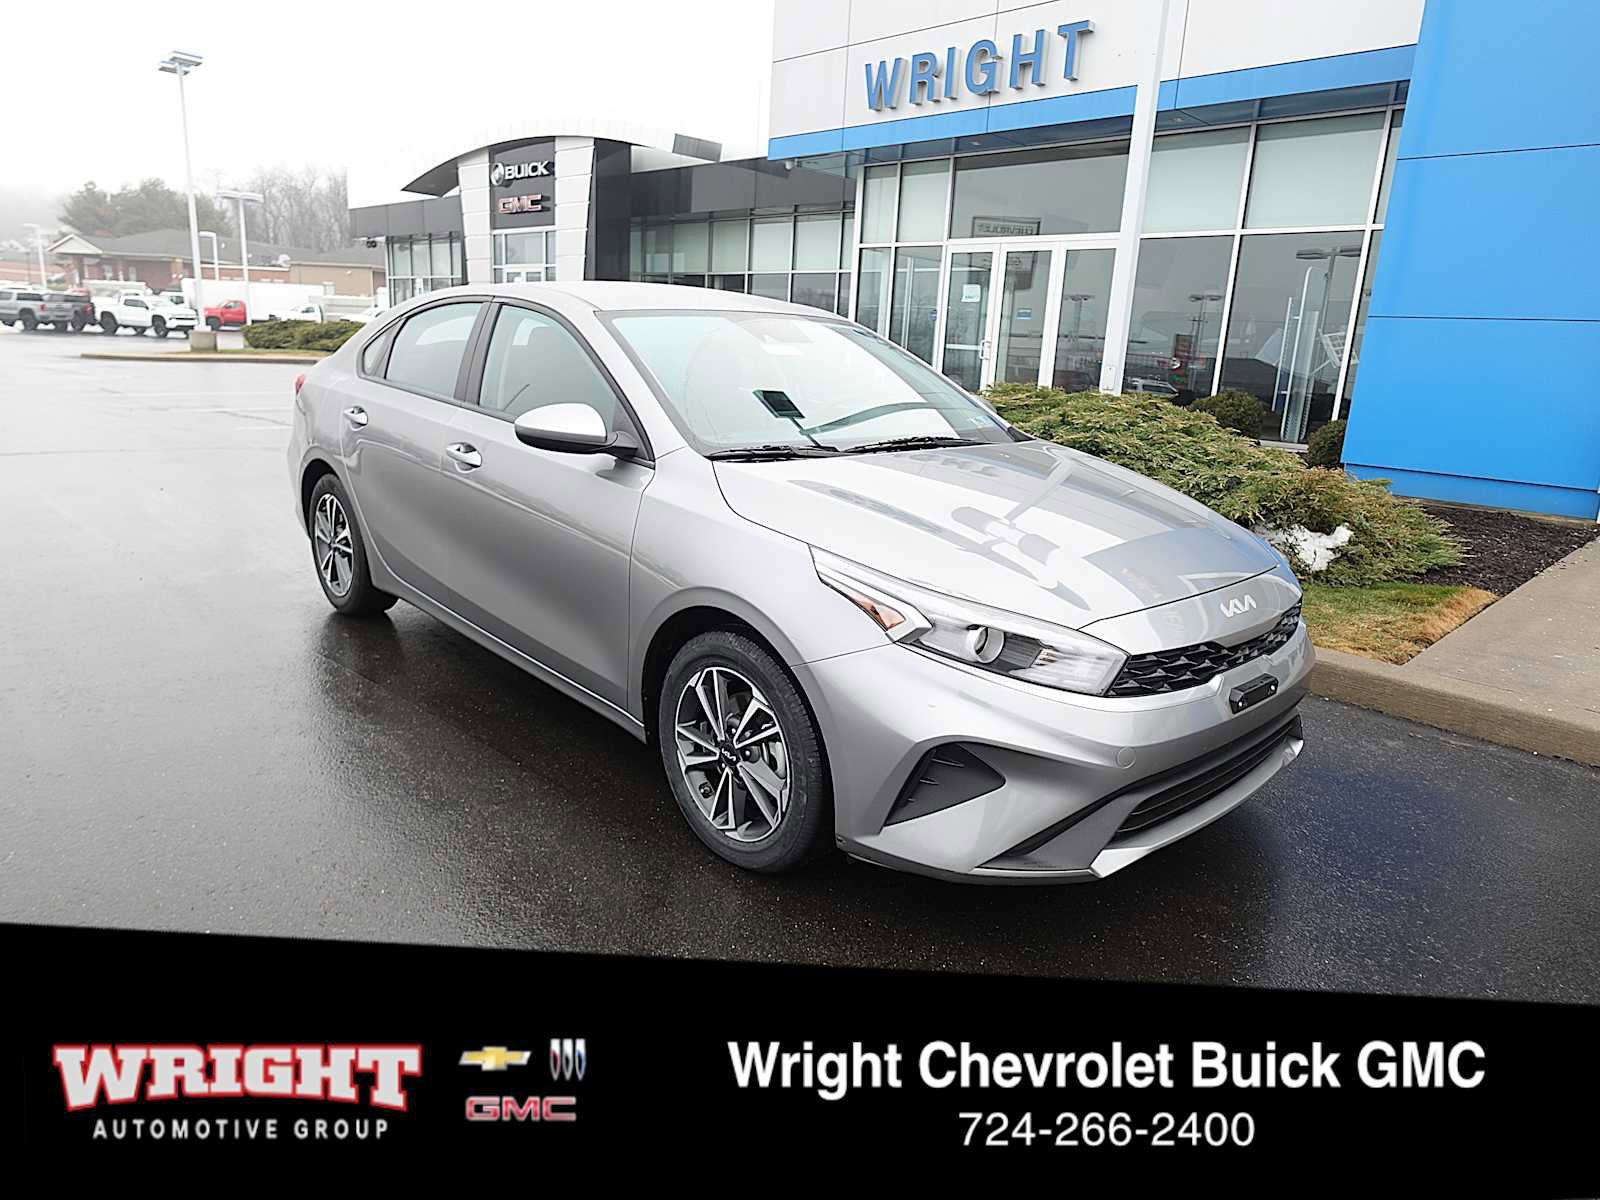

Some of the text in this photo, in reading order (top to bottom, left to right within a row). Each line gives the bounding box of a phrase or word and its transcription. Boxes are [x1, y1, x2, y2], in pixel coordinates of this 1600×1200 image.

[864, 19, 1094, 111] WRIGHT
[504, 161, 549, 180] BUICK
[498, 194, 542, 214] GMC
